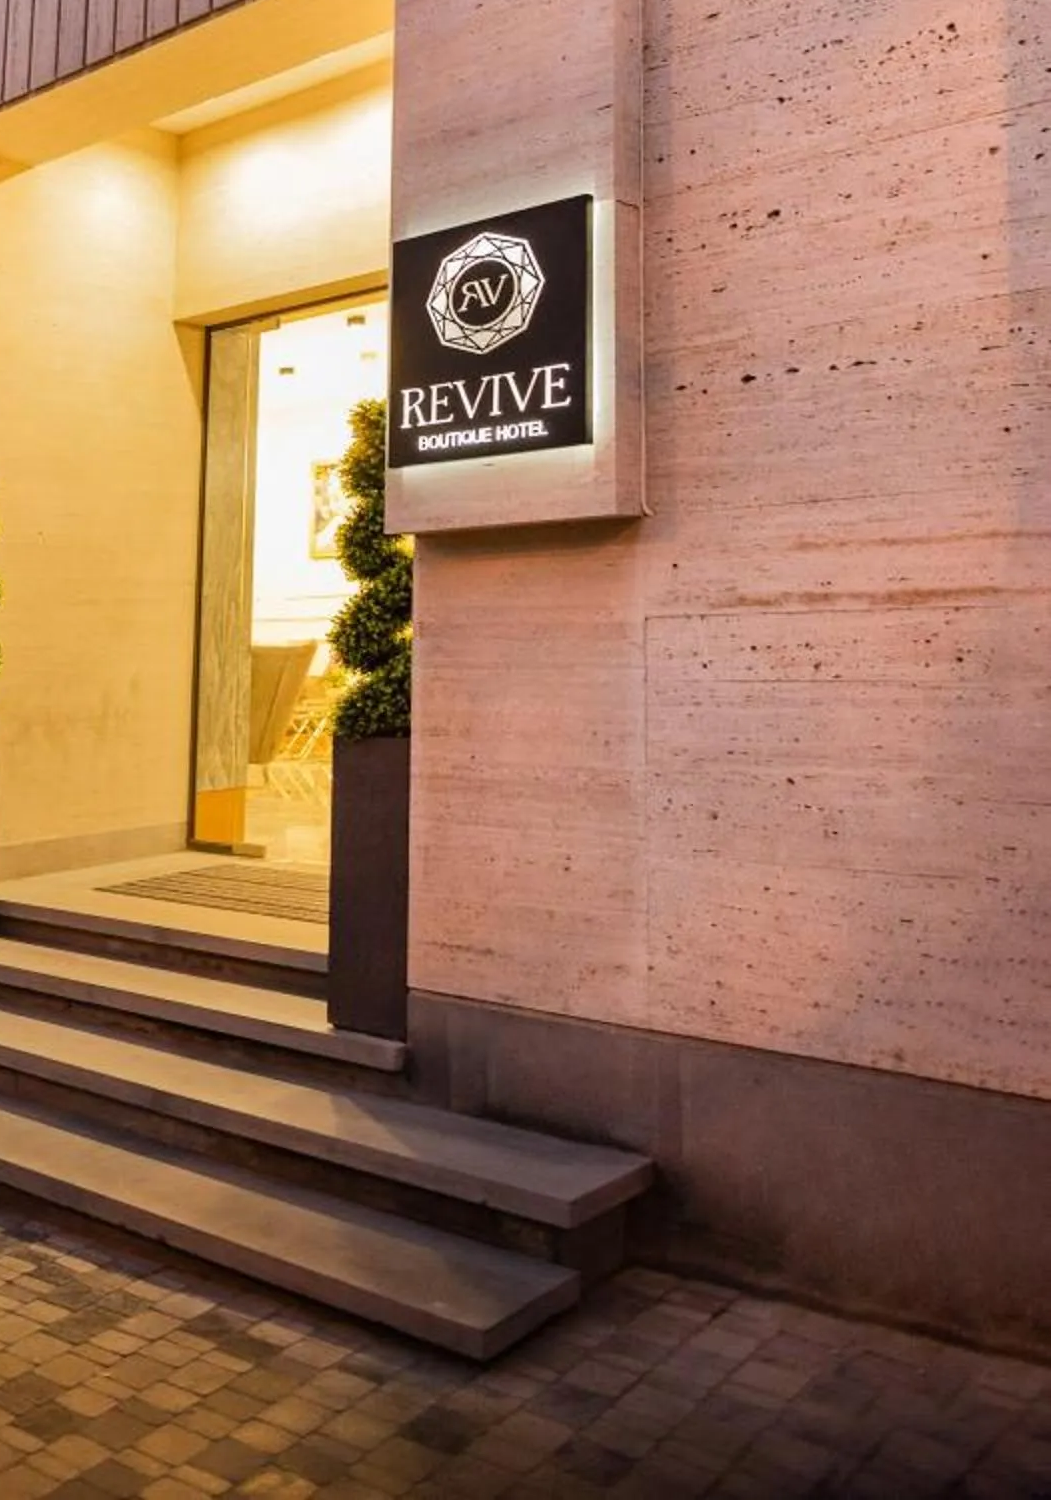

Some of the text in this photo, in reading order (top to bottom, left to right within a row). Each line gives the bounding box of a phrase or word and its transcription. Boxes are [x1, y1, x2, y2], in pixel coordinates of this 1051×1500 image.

[400, 363, 572, 429] REVIVE
[418, 420, 549, 451] BOUTIQUE HOTEL
